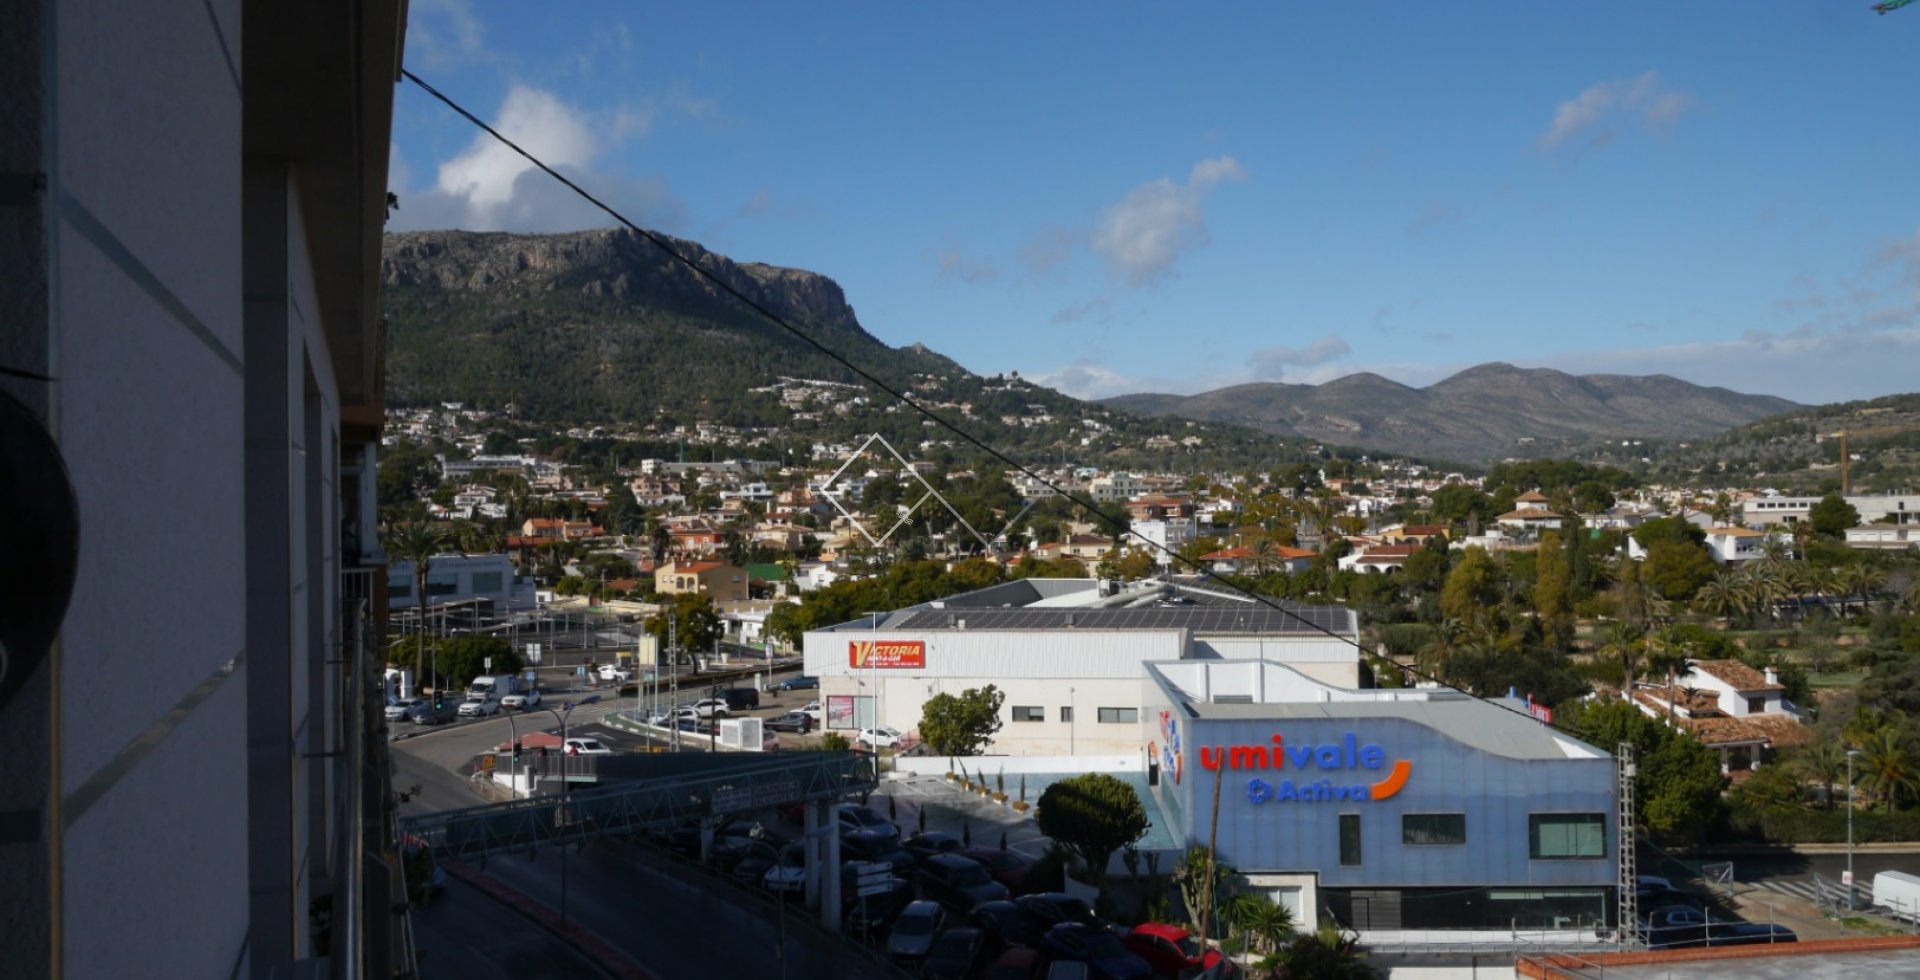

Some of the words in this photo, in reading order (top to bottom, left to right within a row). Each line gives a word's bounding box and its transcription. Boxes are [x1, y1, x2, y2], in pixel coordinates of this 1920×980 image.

[853, 641, 920, 666] VICTORIA
[1200, 731, 1386, 770] umivale
[1277, 778, 1368, 801] Activa
